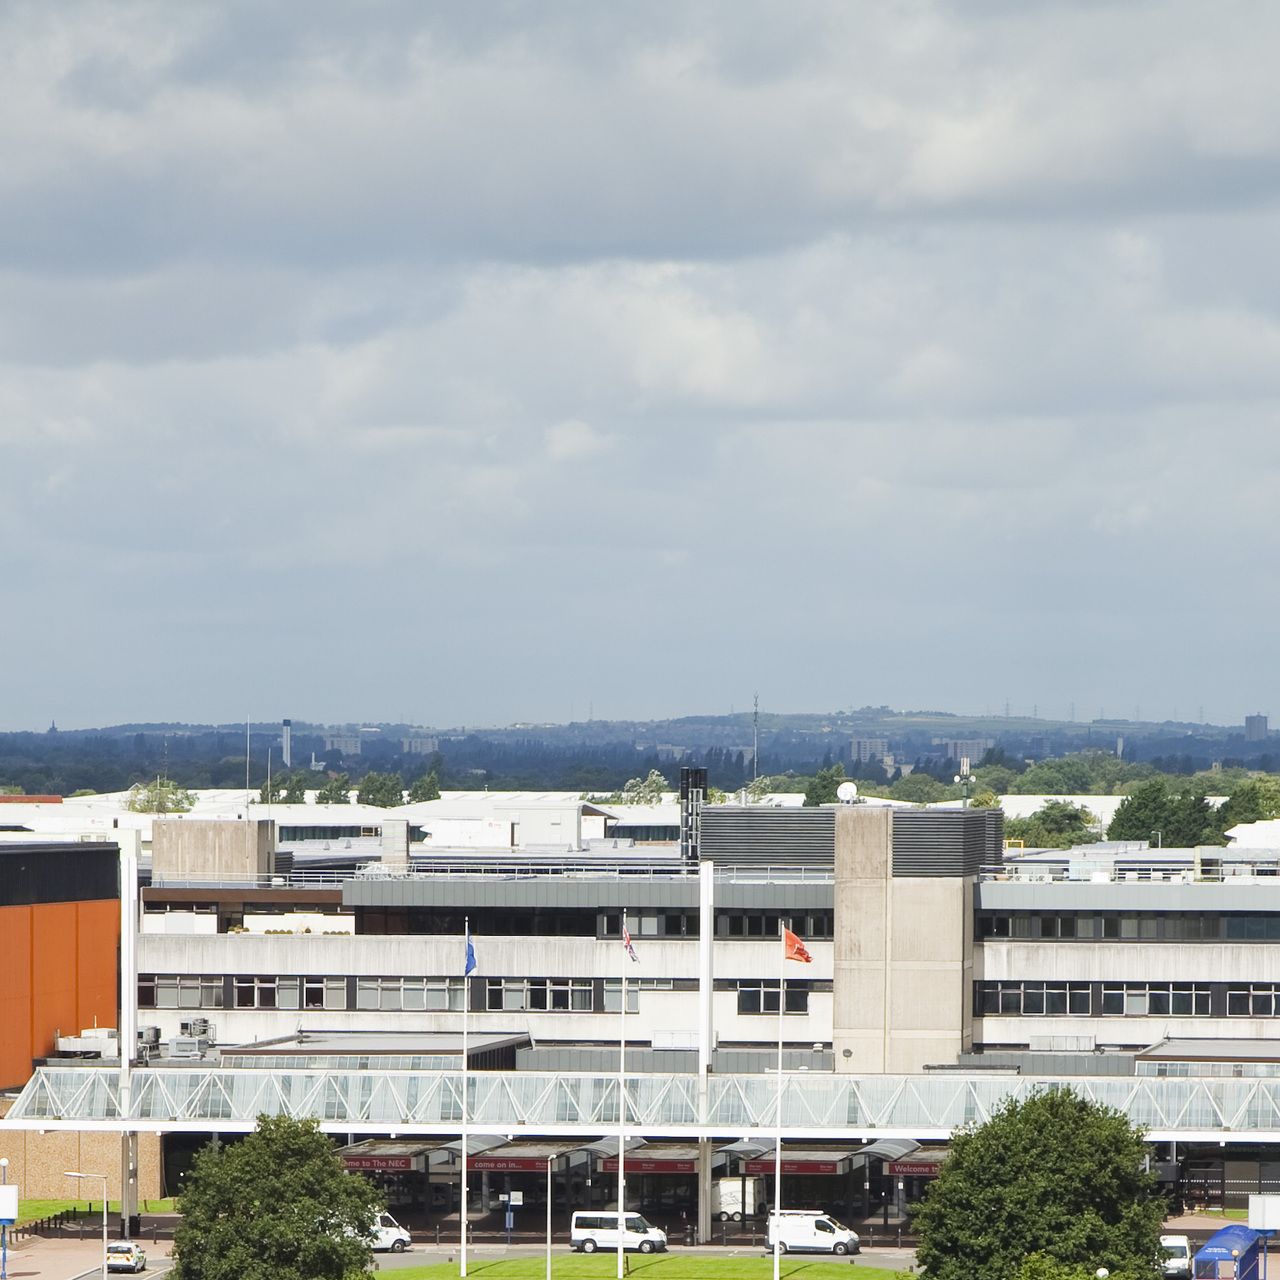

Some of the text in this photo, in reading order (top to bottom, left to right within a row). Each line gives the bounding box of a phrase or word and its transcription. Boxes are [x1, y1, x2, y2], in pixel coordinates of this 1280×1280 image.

[362, 1160, 371, 1168] to
[372, 1159, 387, 1168] The
[388, 1159, 406, 1168] NEC
[474, 1161, 495, 1169] come
[894, 1164, 930, 1173] Welcome
